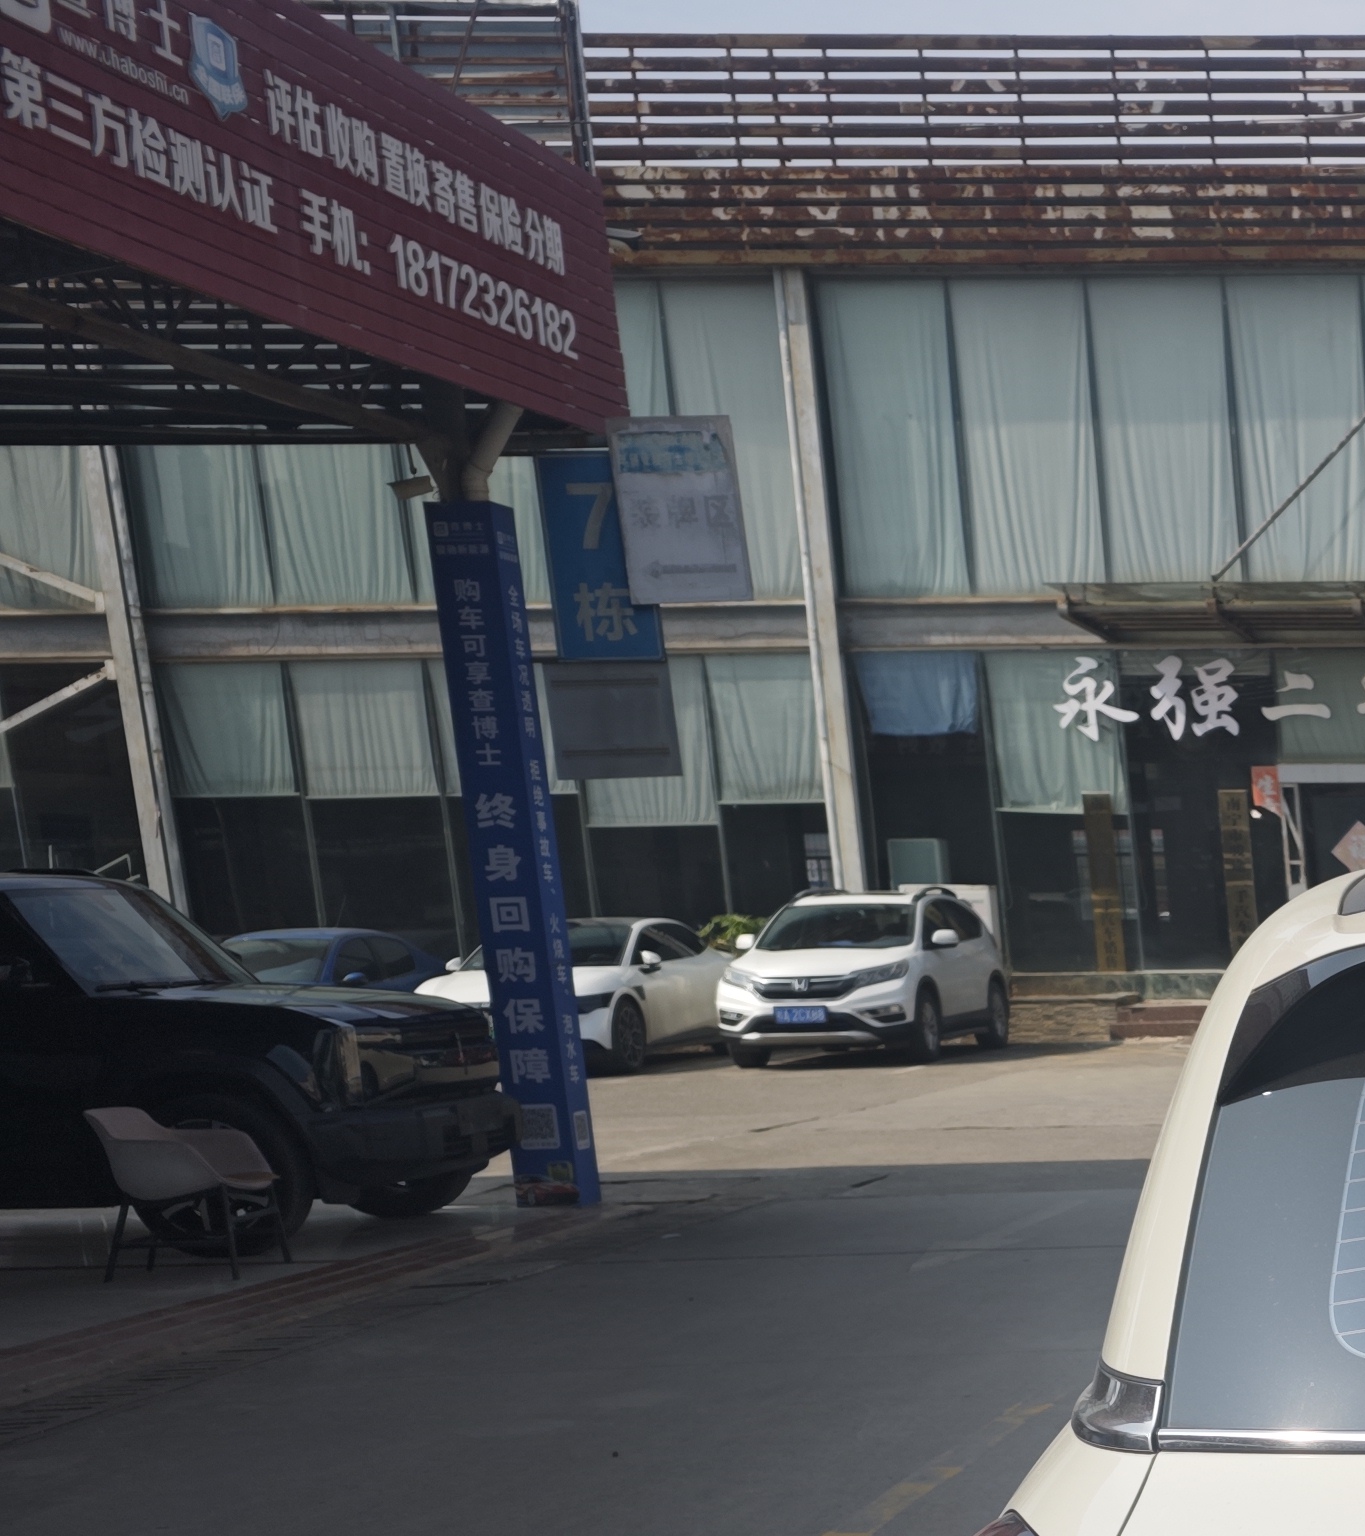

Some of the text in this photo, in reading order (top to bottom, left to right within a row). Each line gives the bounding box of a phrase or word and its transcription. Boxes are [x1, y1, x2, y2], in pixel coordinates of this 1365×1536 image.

[57, 0, 184, 66] 博士
[1, 47, 279, 235] 第三方检测认证
[262, 68, 566, 277] 评估收购置换寄售保险分期
[566, 482, 638, 642] 7栋
[453, 578, 502, 766] 购车可享查博士
[475, 793, 550, 1085] 终身回购保障
